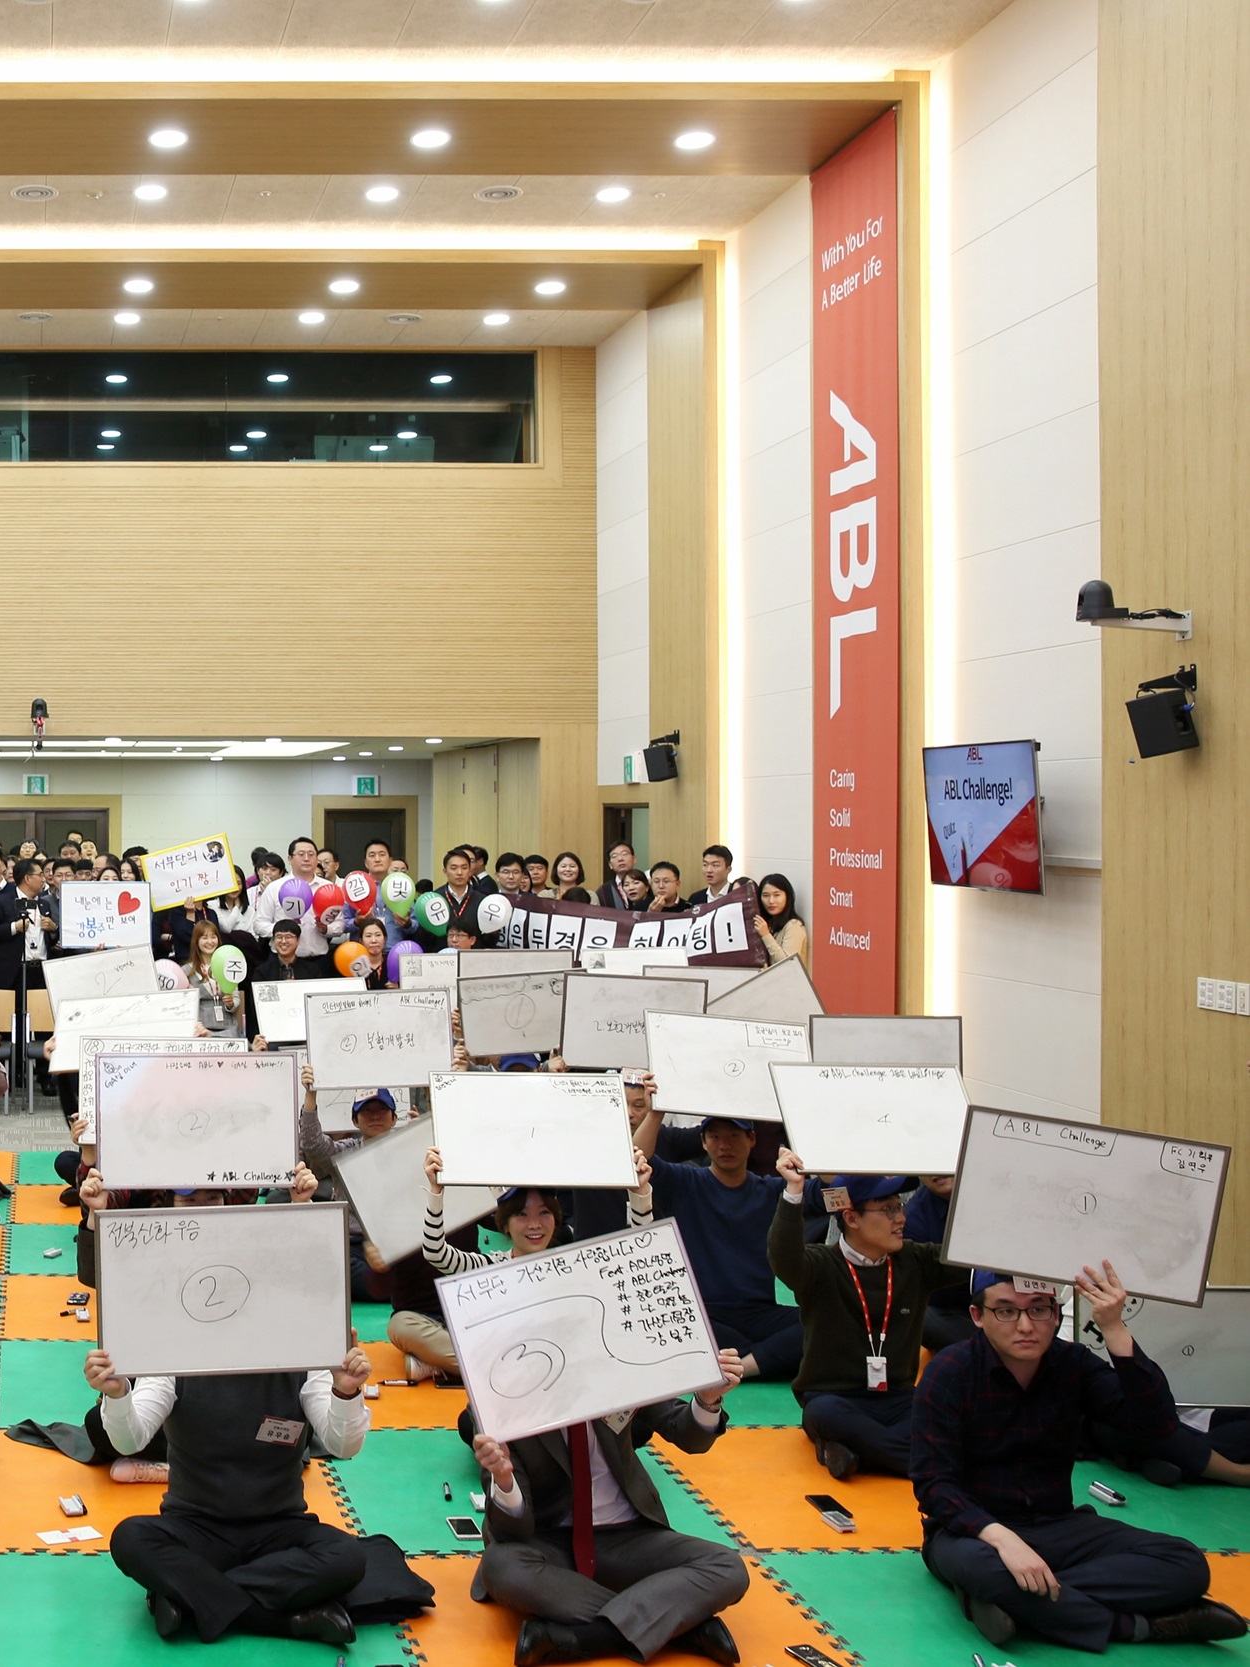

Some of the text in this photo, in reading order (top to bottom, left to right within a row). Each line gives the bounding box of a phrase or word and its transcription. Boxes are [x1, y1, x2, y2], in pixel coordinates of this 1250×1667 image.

[821, 216, 883, 272] With You For
[821, 255, 882, 312] A Better Life
[830, 389, 877, 720] ABL
[967, 747, 983, 761] ABL
[829, 768, 855, 792] Caring
[944, 777, 1014, 806] ABL Challenge!
[829, 808, 850, 828] Solid
[155, 850, 198, 870] 서부단의
[829, 848, 883, 870] Professional
[170, 877, 192, 893] 인기
[829, 887, 853, 908] Smart
[829, 927, 871, 951] Advanced
[226, 961, 243, 980] 주
[831, 1067, 850, 1079] ABL
[1059, 1127, 1107, 1150] Challenge
[222, 1170, 282, 1182] ABL Challenge
[456, 1240, 634, 1306] 서부단 가산지점 사랑합니다
